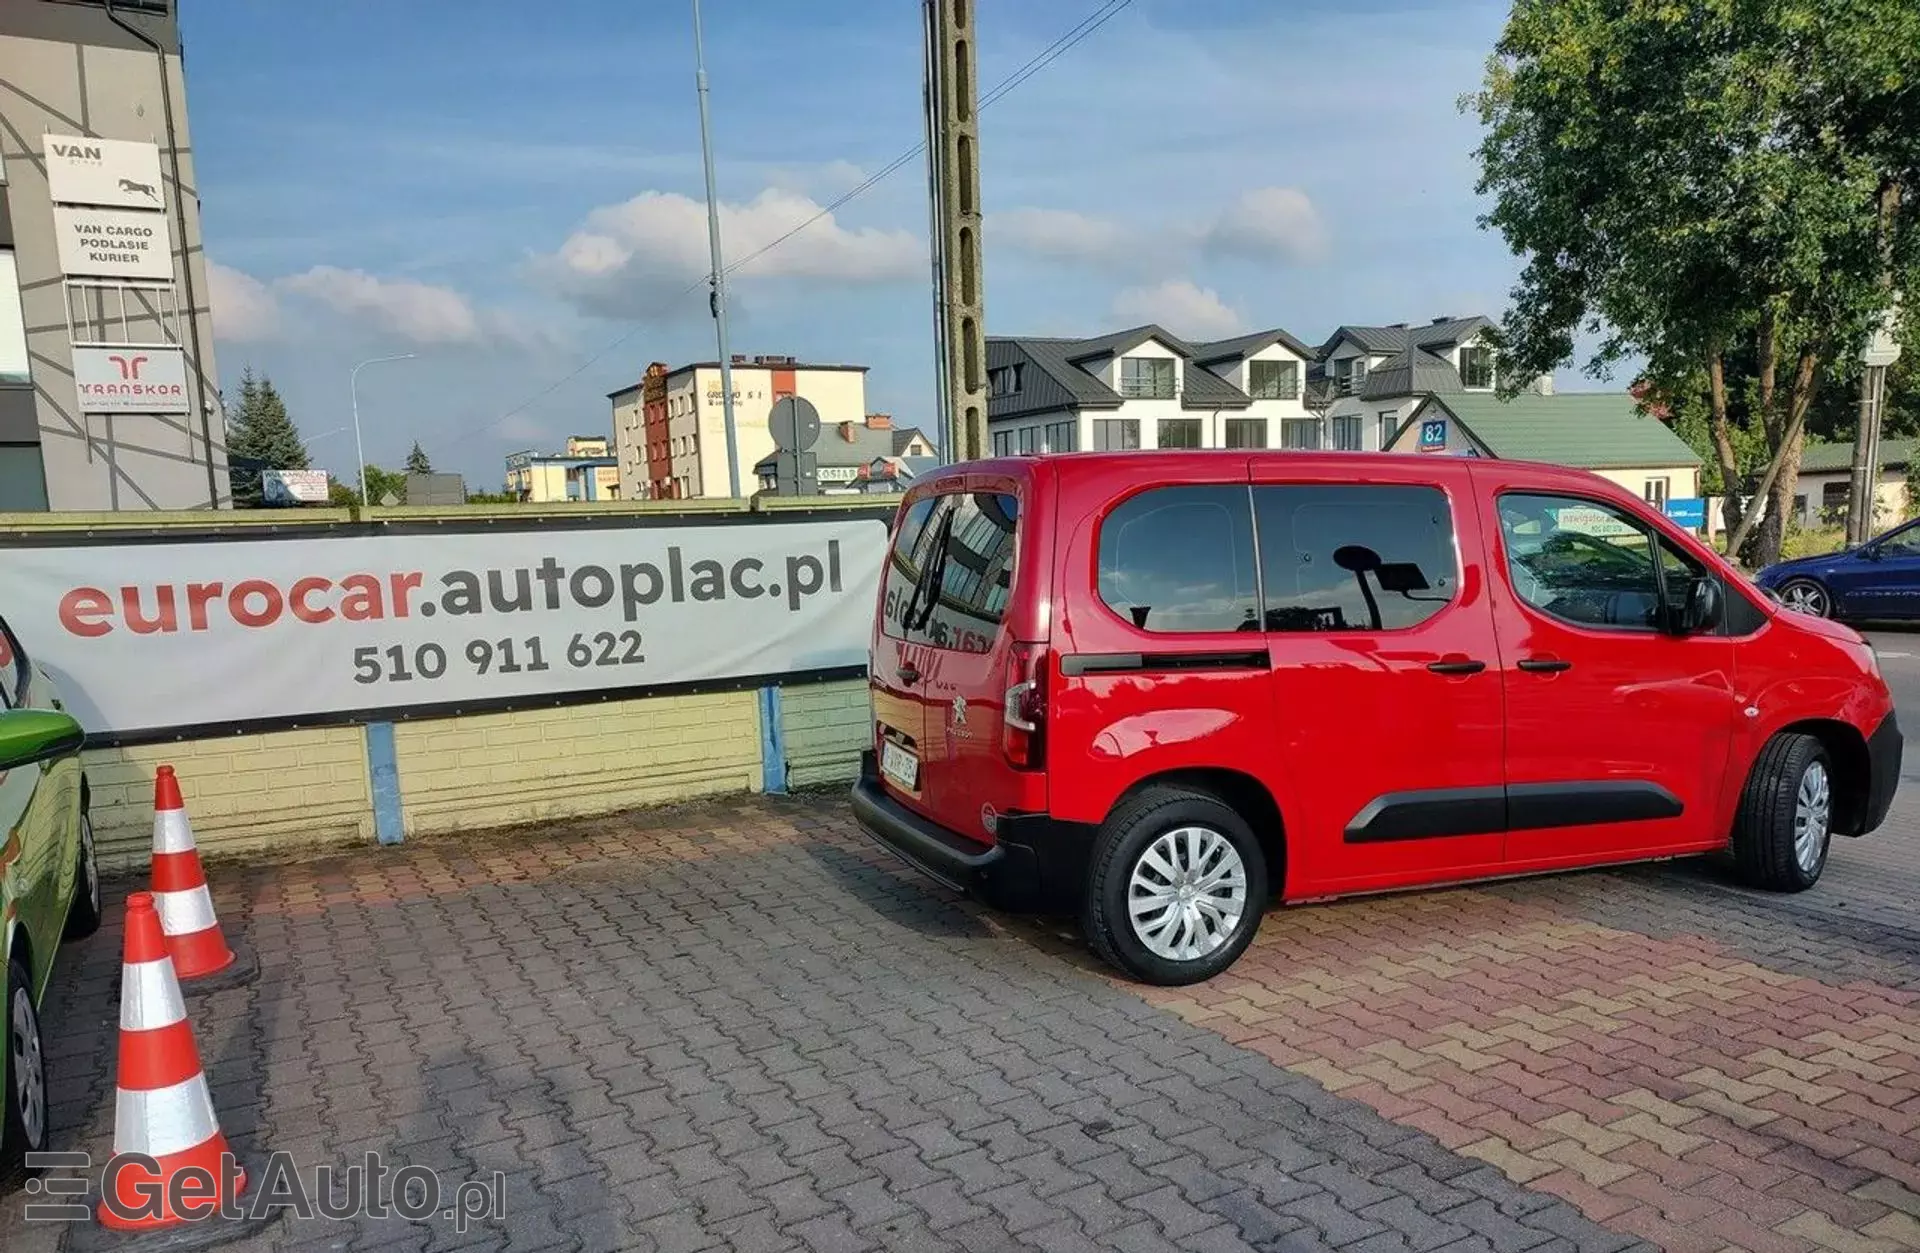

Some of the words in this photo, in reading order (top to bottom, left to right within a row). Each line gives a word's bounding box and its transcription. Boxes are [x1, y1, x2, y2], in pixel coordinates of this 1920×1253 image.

[52, 144, 102, 160] VAN
[74, 224, 102, 234] VAN
[106, 226, 153, 237] CARGO
[80, 238, 149, 250] PODLASIE
[89, 252, 140, 263] KURIER
[78, 383, 182, 396] TRANSKOR
[1425, 423, 1443, 442] 82
[58, 539, 843, 638] eurocar.autoplac.pl
[353, 642, 448, 685] 510
[465, 636, 549, 676] 911
[567, 630, 646, 668] 622
